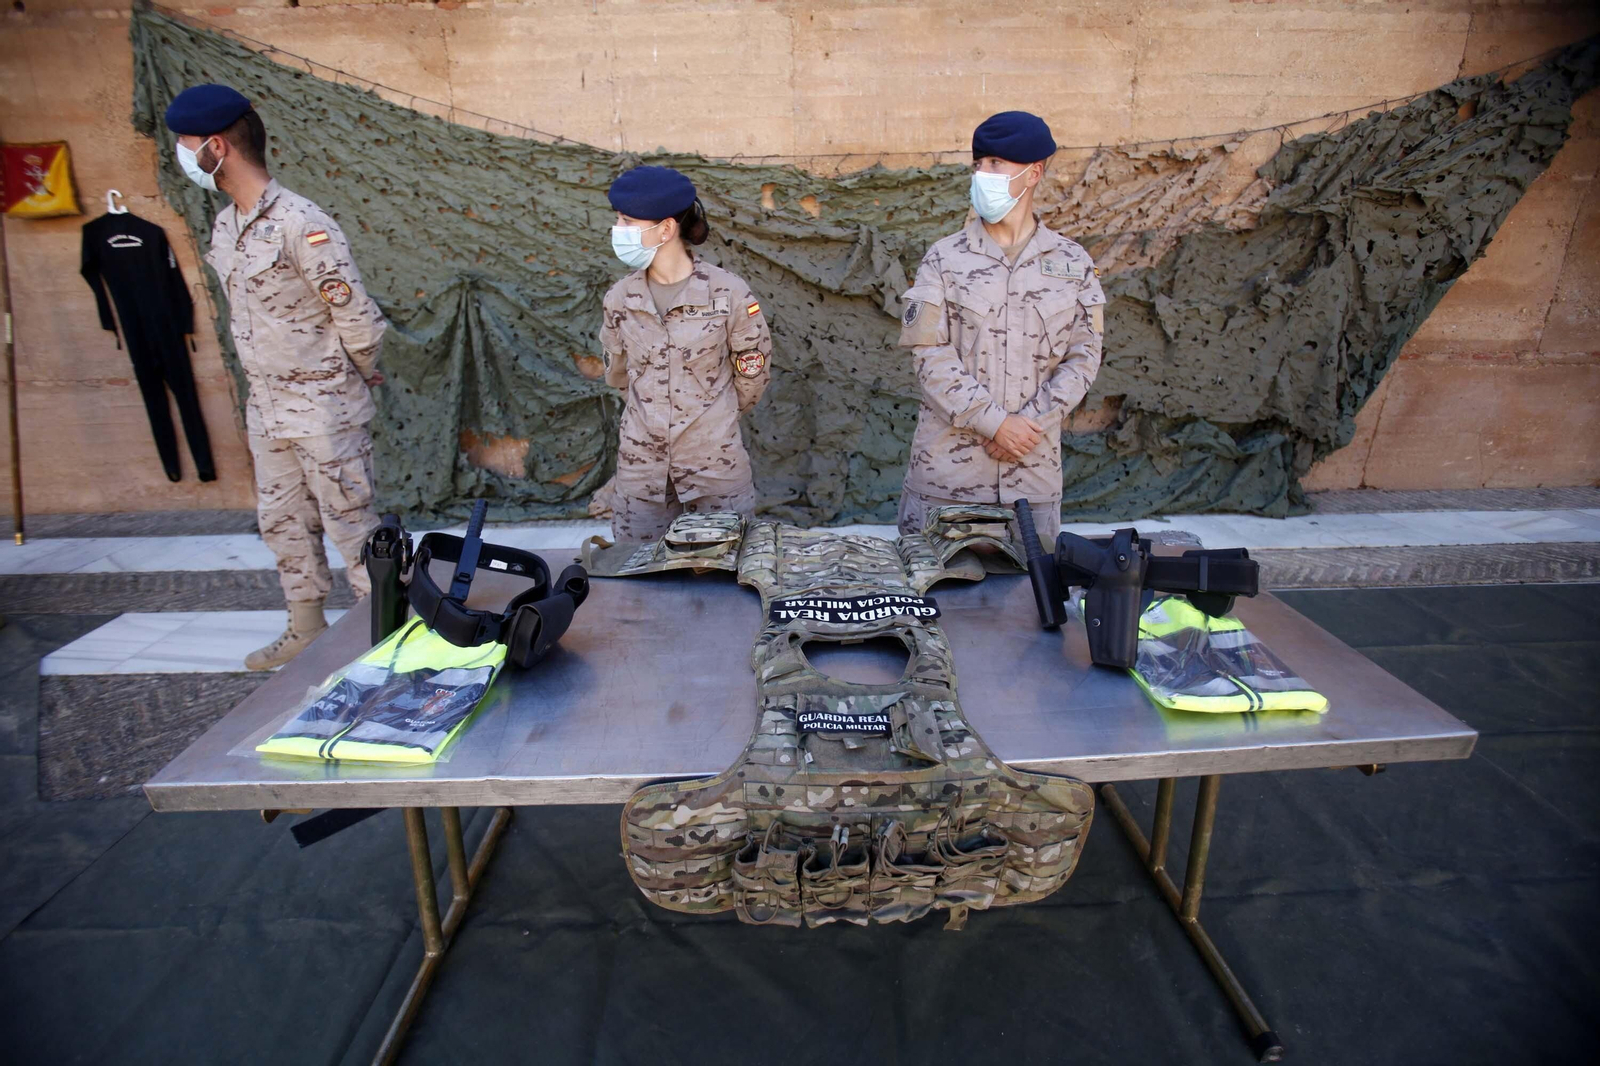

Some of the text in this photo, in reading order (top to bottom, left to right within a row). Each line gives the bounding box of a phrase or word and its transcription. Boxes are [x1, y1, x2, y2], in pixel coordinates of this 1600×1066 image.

[785, 596, 925, 609] POLICIA MILITAR
[774, 606, 937, 622] GUARDIA REAL
[799, 712, 891, 723] GUARDIA REAL
[803, 722, 843, 730] POLICIA
